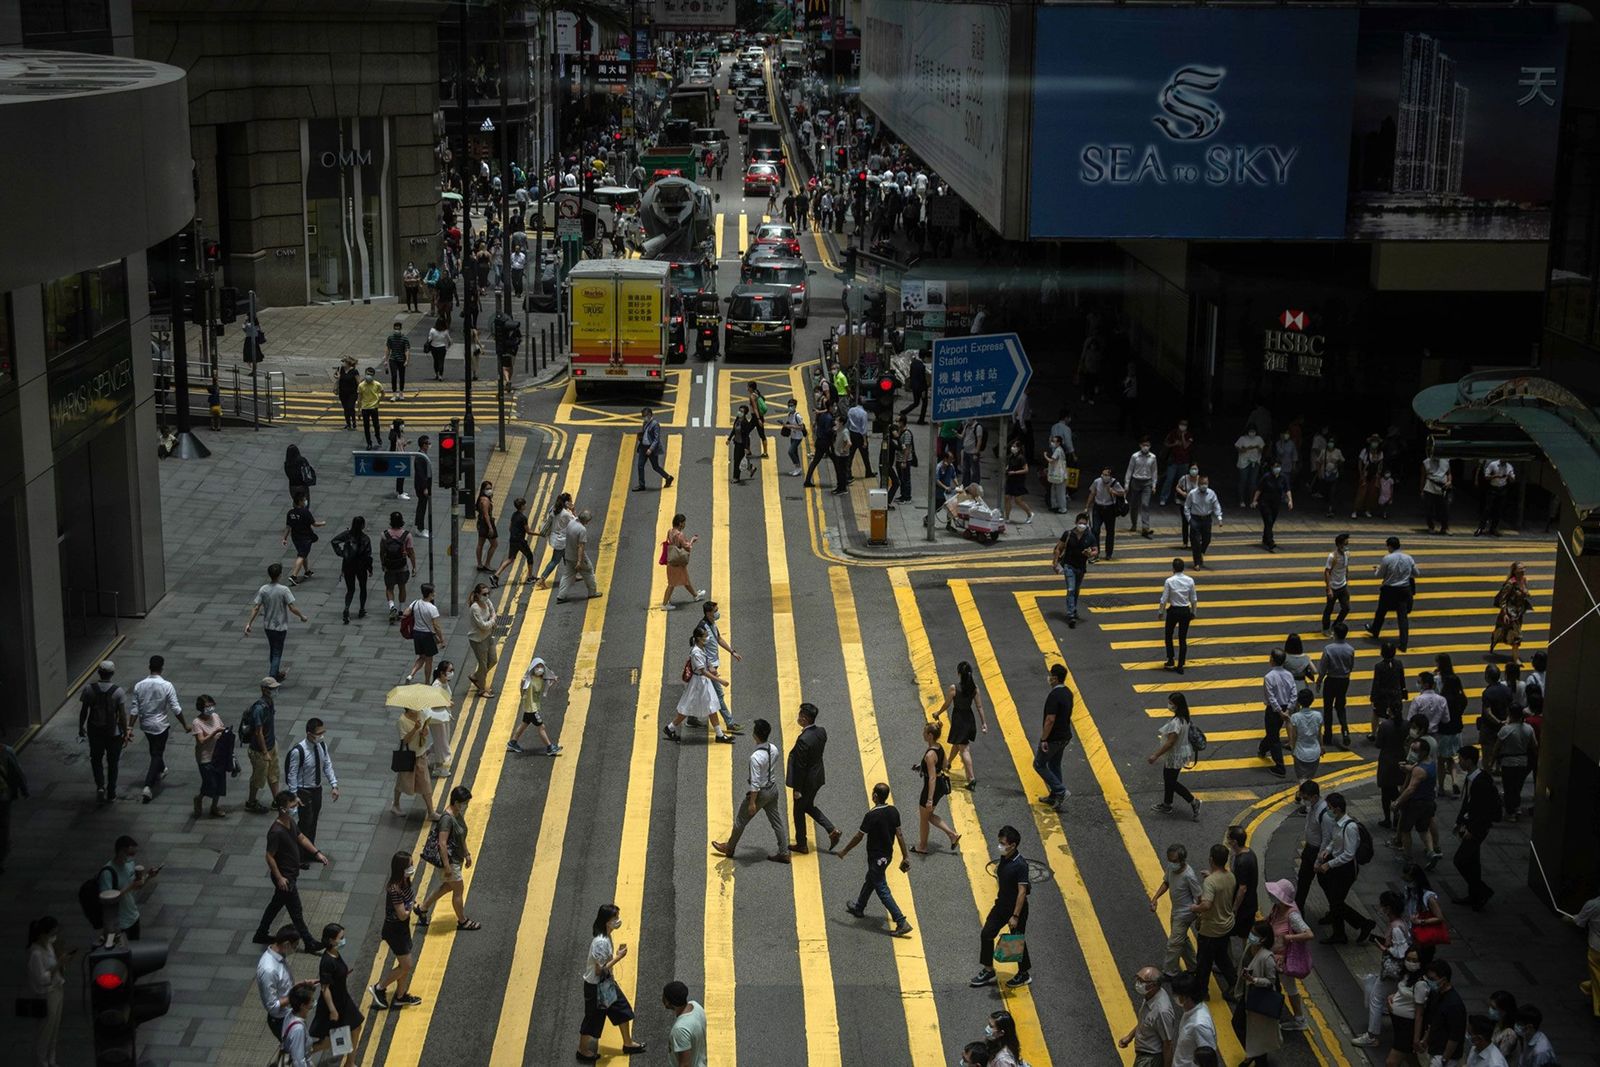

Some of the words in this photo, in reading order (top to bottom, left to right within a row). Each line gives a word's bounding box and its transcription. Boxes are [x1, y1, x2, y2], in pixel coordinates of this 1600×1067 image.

[1516, 66, 1557, 107] 天
[1081, 145, 1167, 184] SEA
[1173, 165, 1200, 184] TO
[1205, 145, 1298, 185] SKY
[939, 345, 968, 357] Airport
[970, 342, 1005, 353] Express
[1264, 329, 1326, 357] HSBC
[938, 356, 968, 367] Station
[51, 385, 87, 430] MARKS
[93, 358, 132, 402] SPENCER
[937, 384, 972, 396] Kowloon
